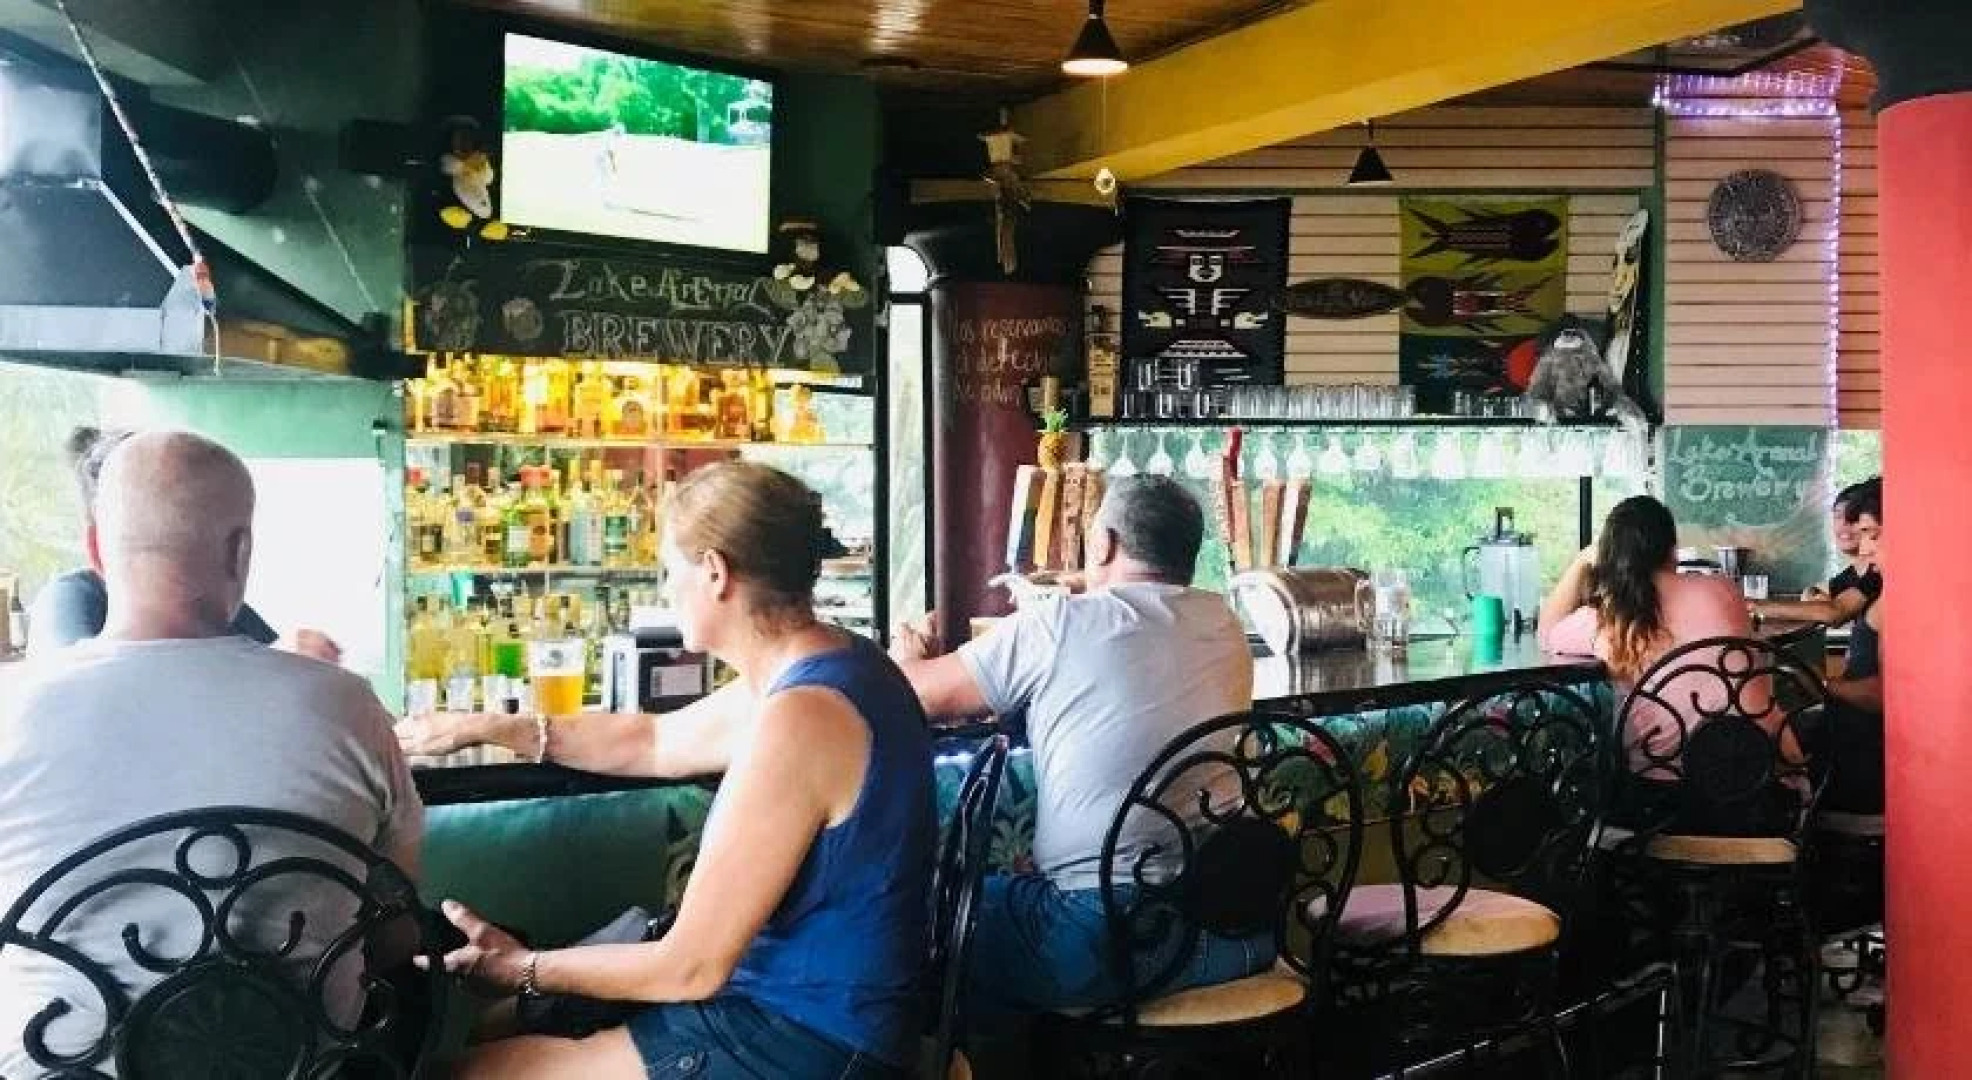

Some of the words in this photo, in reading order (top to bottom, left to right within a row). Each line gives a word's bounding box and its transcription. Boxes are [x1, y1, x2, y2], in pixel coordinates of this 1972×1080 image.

[525, 259, 648, 302] Lake
[556, 310, 793, 366] BREWERY
[1667, 426, 1729, 464] Lake
[1730, 426, 1819, 475] Arenal
[1680, 465, 1805, 507] Brewery
